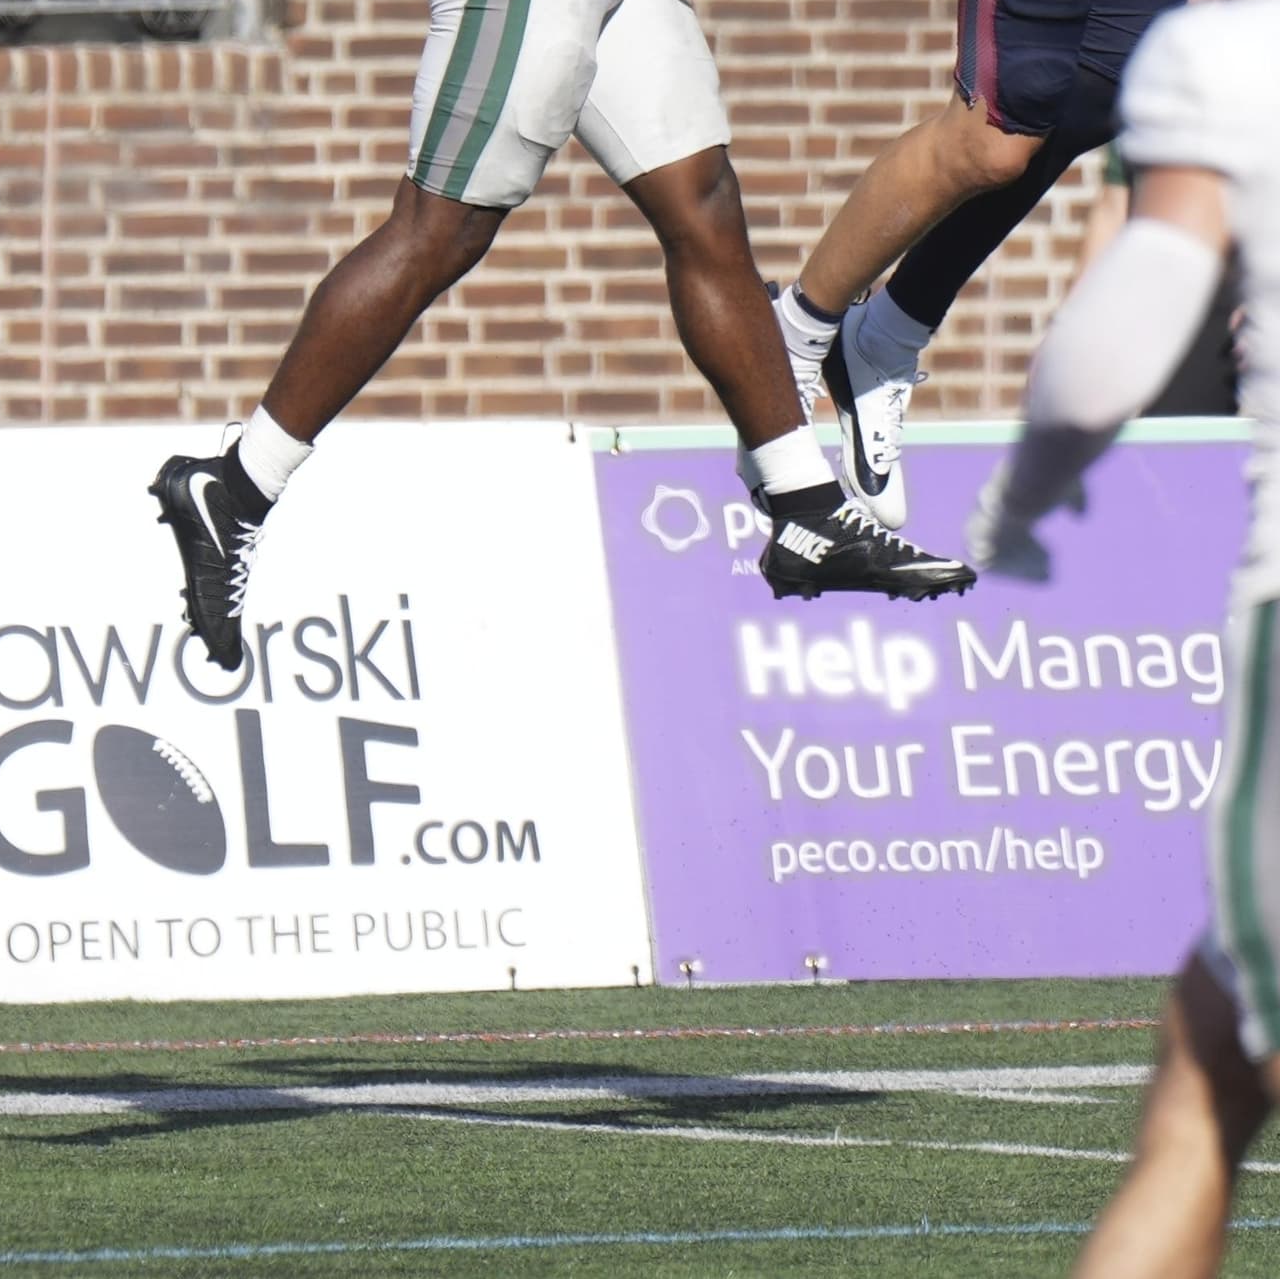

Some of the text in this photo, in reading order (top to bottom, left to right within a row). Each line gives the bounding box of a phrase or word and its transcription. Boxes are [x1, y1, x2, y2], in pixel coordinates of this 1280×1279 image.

[776, 521, 835, 565] NIKE
[740, 620, 1225, 711] Help Manag
[741, 724, 1223, 812] Your Energy
[771, 826, 1104, 884] peco.com/help
[6, 907, 527, 963] OPEN TO THE PUBLIC
